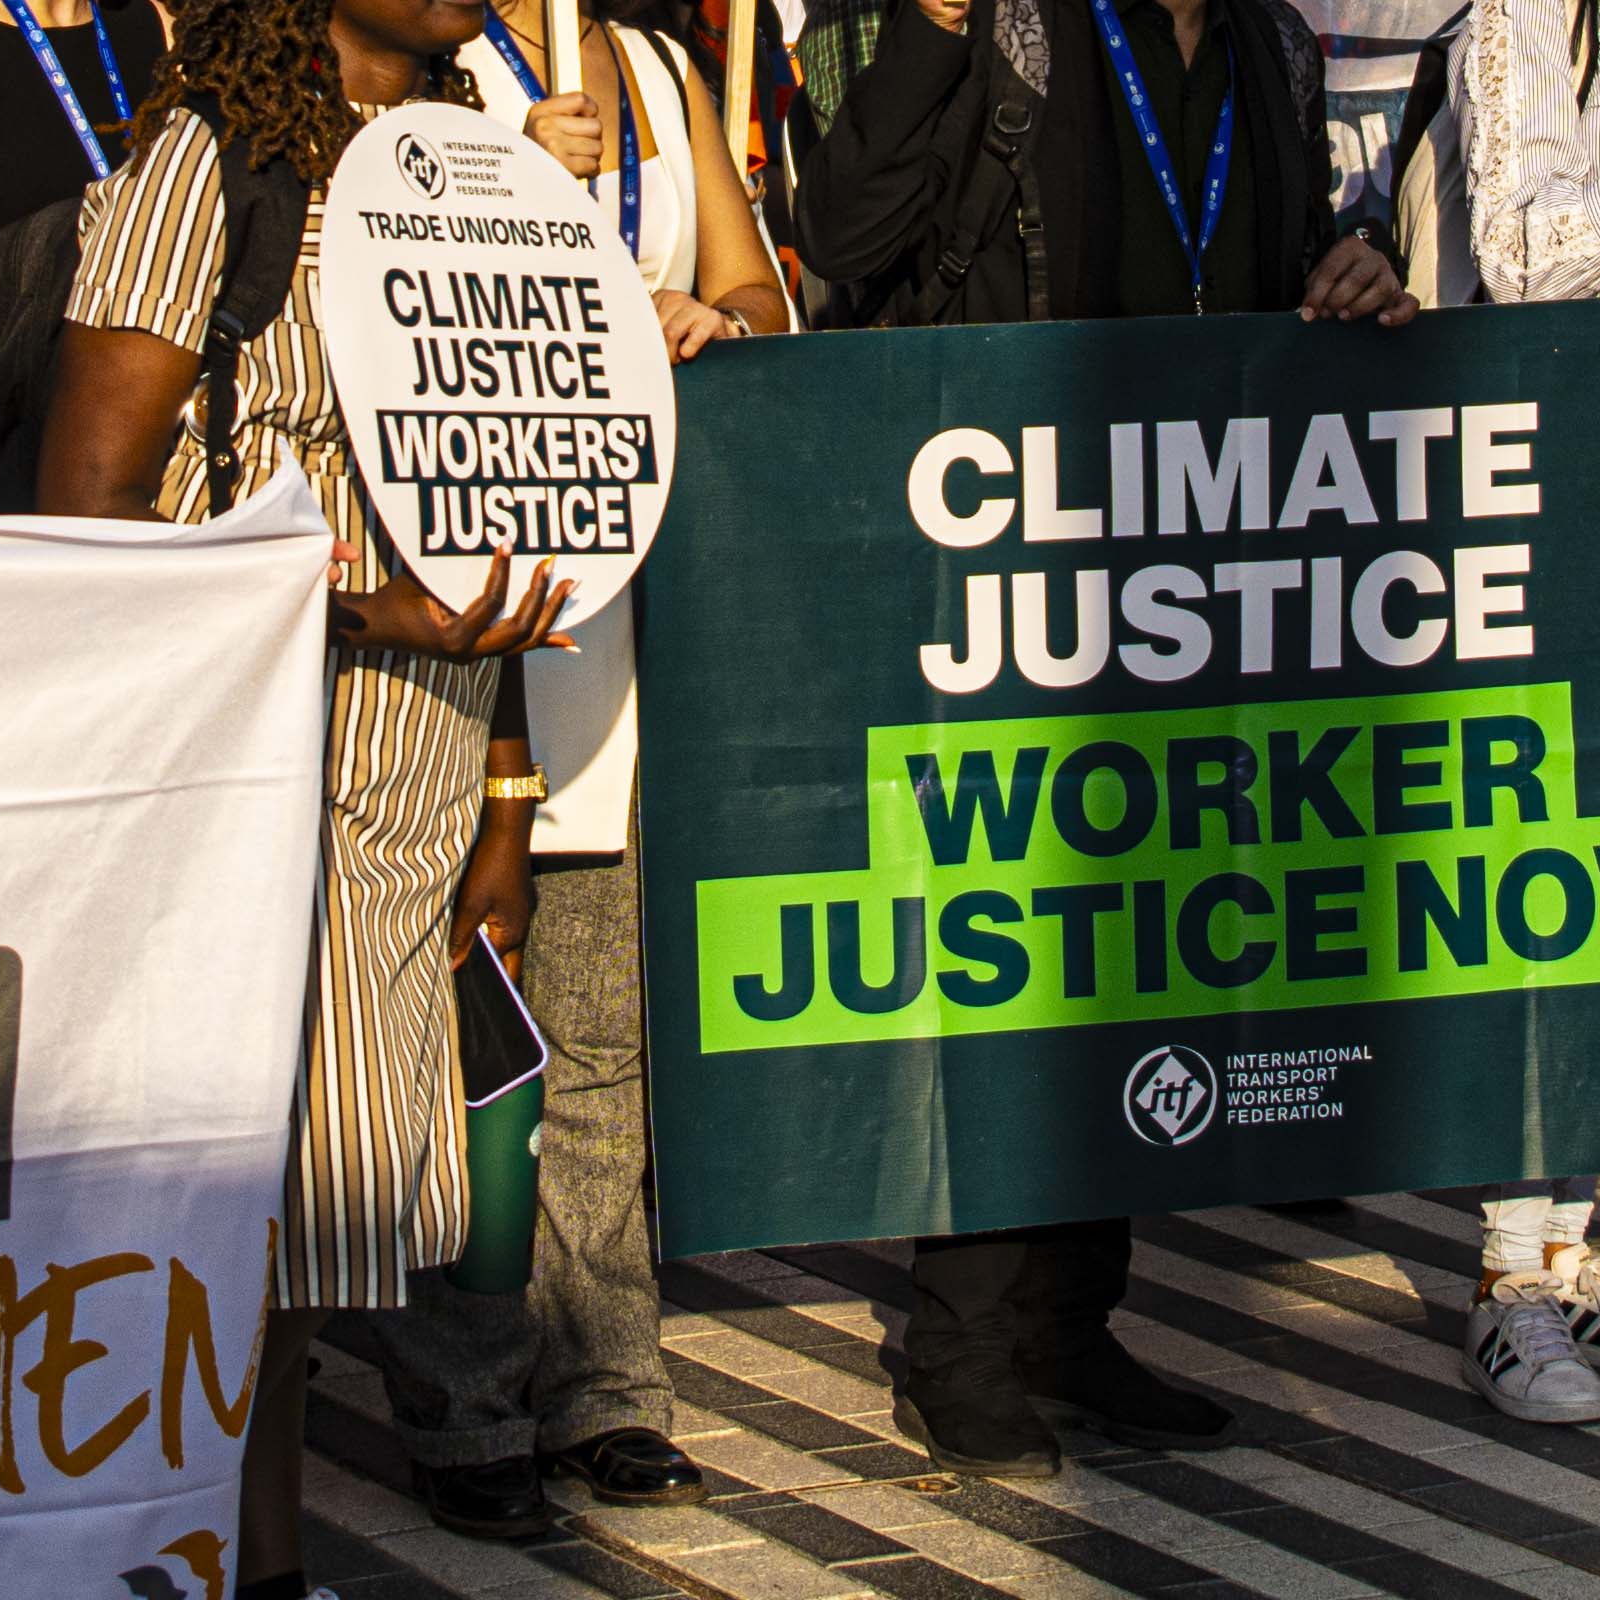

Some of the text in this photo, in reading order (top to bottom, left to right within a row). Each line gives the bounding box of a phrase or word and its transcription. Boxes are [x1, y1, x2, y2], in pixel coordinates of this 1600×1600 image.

[442, 141, 515, 155] INTERNATIONAL
[447, 156, 501, 168] TRANSPORT
[456, 186, 514, 198] FEDERATION
[359, 211, 596, 250] TRADE UNIONS FOR
[383, 268, 609, 334] CLIMATE
[412, 336, 611, 400] JUSTICE
[384, 414, 647, 481] WORKERS'
[907, 401, 1542, 549] CLIMATE
[426, 484, 630, 552] JUSTICE
[919, 543, 1535, 694] JUSTICE
[905, 713, 1549, 866] WORKER
[732, 864, 1369, 1022] JUSTICE
[1226, 1045, 1372, 1070] INTERNATIONAL
[1226, 1066, 1338, 1088] TRANSPORT
[1226, 1086, 1324, 1106] WORKERS'
[1227, 1102, 1343, 1125] FEDERATION
